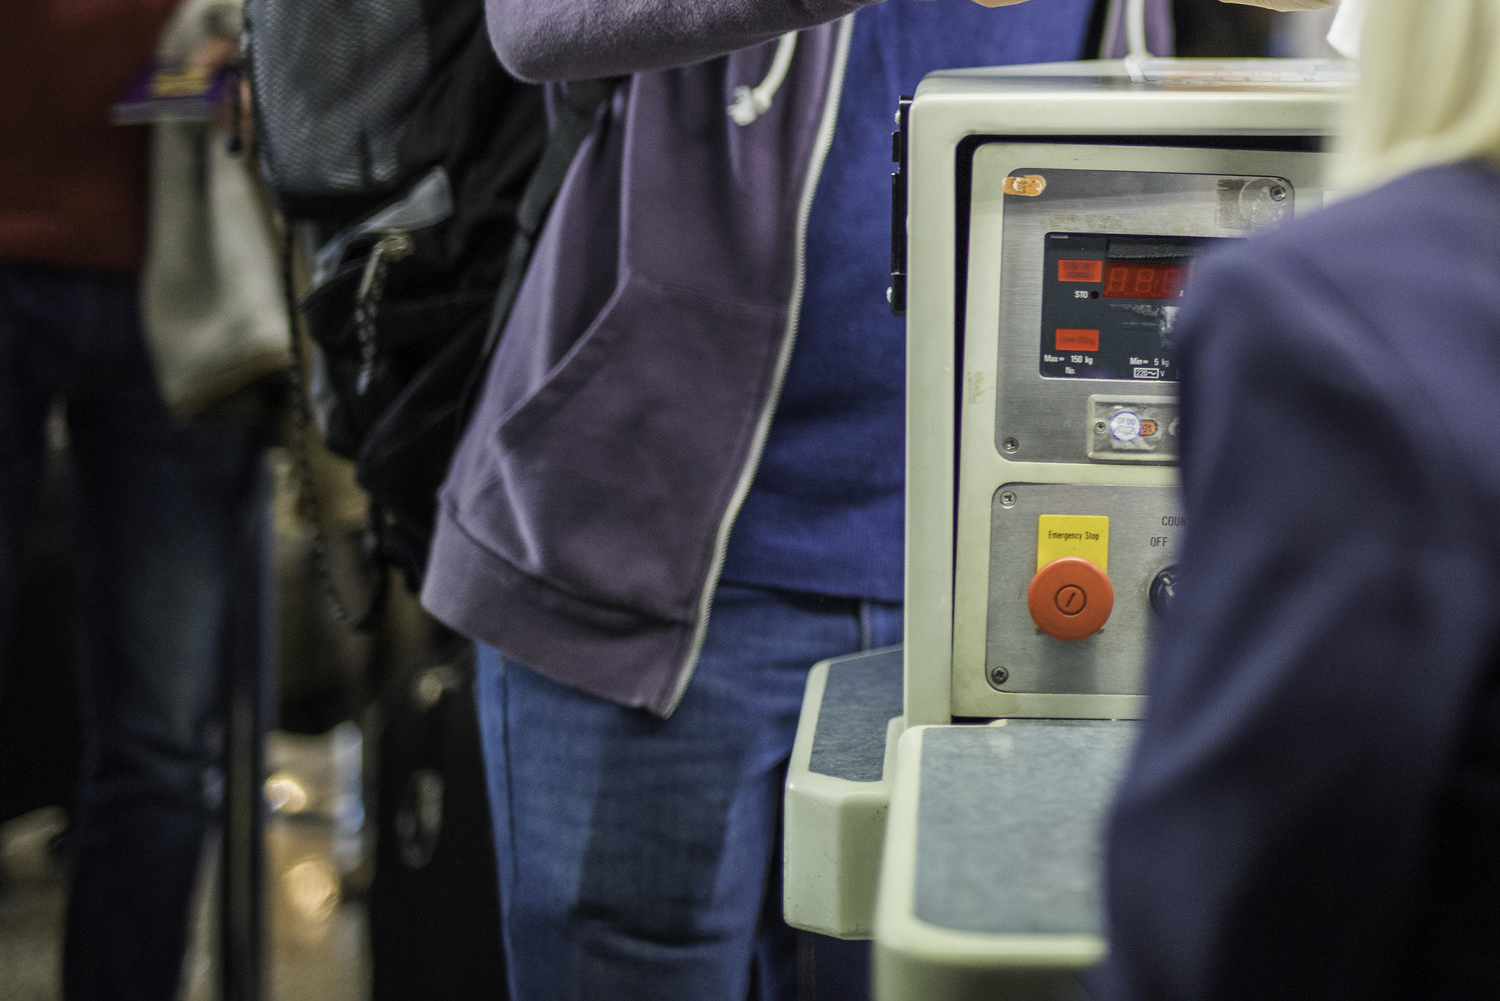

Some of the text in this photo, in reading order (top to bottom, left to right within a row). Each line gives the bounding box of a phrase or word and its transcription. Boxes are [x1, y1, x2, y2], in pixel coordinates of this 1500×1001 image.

[1070, 355, 1083, 364] 150
[1084, 355, 1094, 366] kg
[1153, 357, 1160, 366] 5
[1161, 358, 1170, 368] kg
[1048, 530, 1101, 541] Emergency Stop
[1150, 536, 1169, 548] OFF
